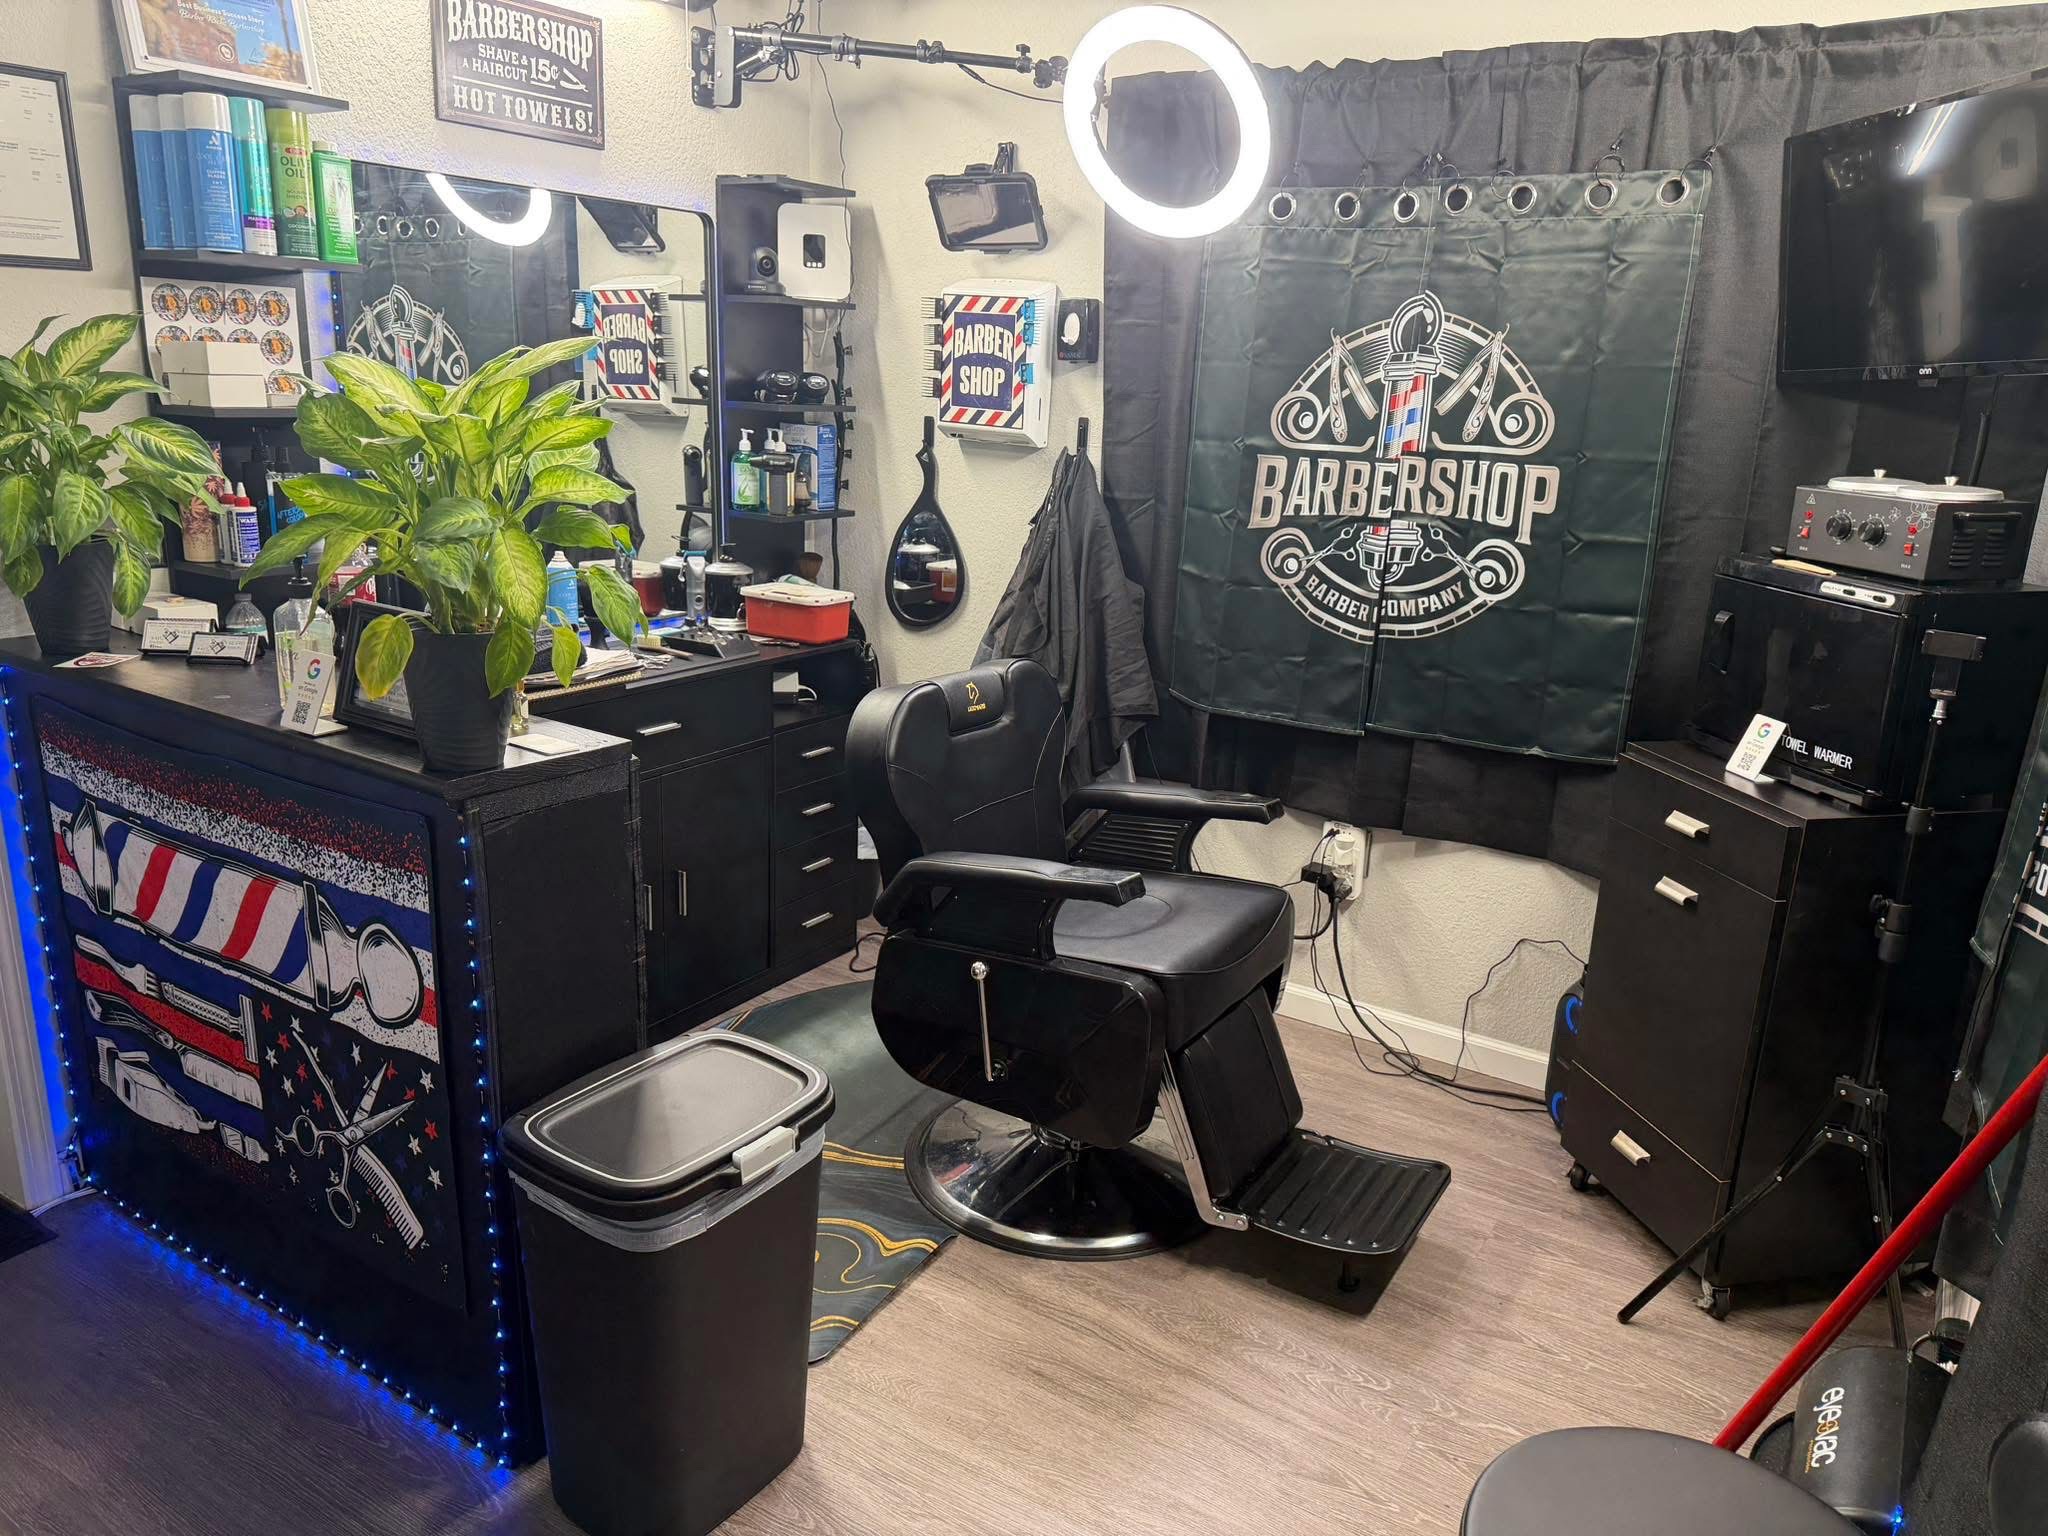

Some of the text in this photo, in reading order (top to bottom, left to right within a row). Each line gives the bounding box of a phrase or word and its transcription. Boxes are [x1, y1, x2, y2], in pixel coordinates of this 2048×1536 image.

[447, 0, 594, 72] BARBERSHOP
[478, 43, 529, 66] SHAVE &
[462, 57, 528, 82] A HAIRCUT
[453, 84, 594, 134] HOT TOWELS!
[285, 167, 305, 178] OIL
[954, 323, 1014, 363] BARBER
[959, 365, 1006, 397] SHOP
[1247, 454, 1560, 545] BARBERSHOP
[1305, 574, 1466, 624] BARBER COMPANY
[1781, 734, 1809, 755] TOWEL
[1813, 745, 1853, 770] WARMER
